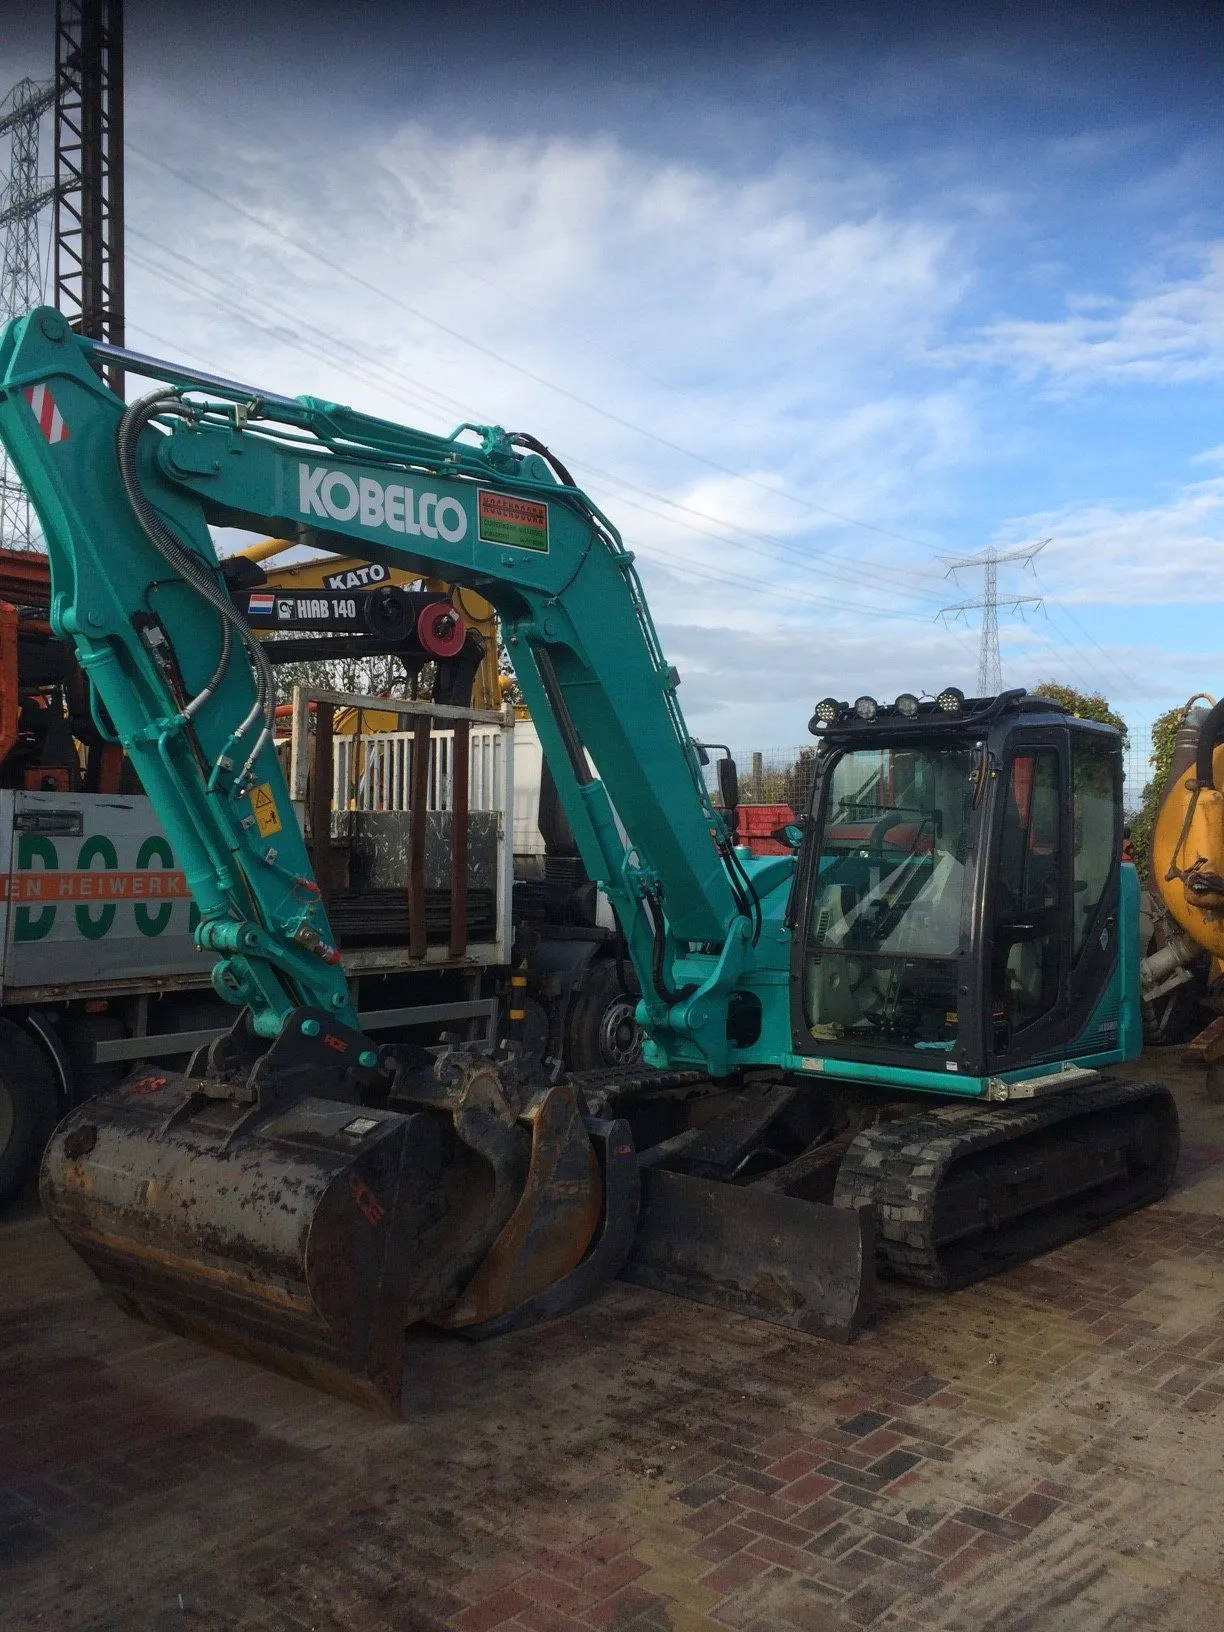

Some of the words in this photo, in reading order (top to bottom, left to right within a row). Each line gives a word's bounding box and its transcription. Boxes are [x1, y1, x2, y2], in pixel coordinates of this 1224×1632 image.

[299, 463, 468, 543] KOBELCO
[329, 564, 385, 589] KATO
[297, 600, 329, 618] HIAB
[332, 600, 356, 618] 140
[59, 876, 189, 896] HEIWERK
